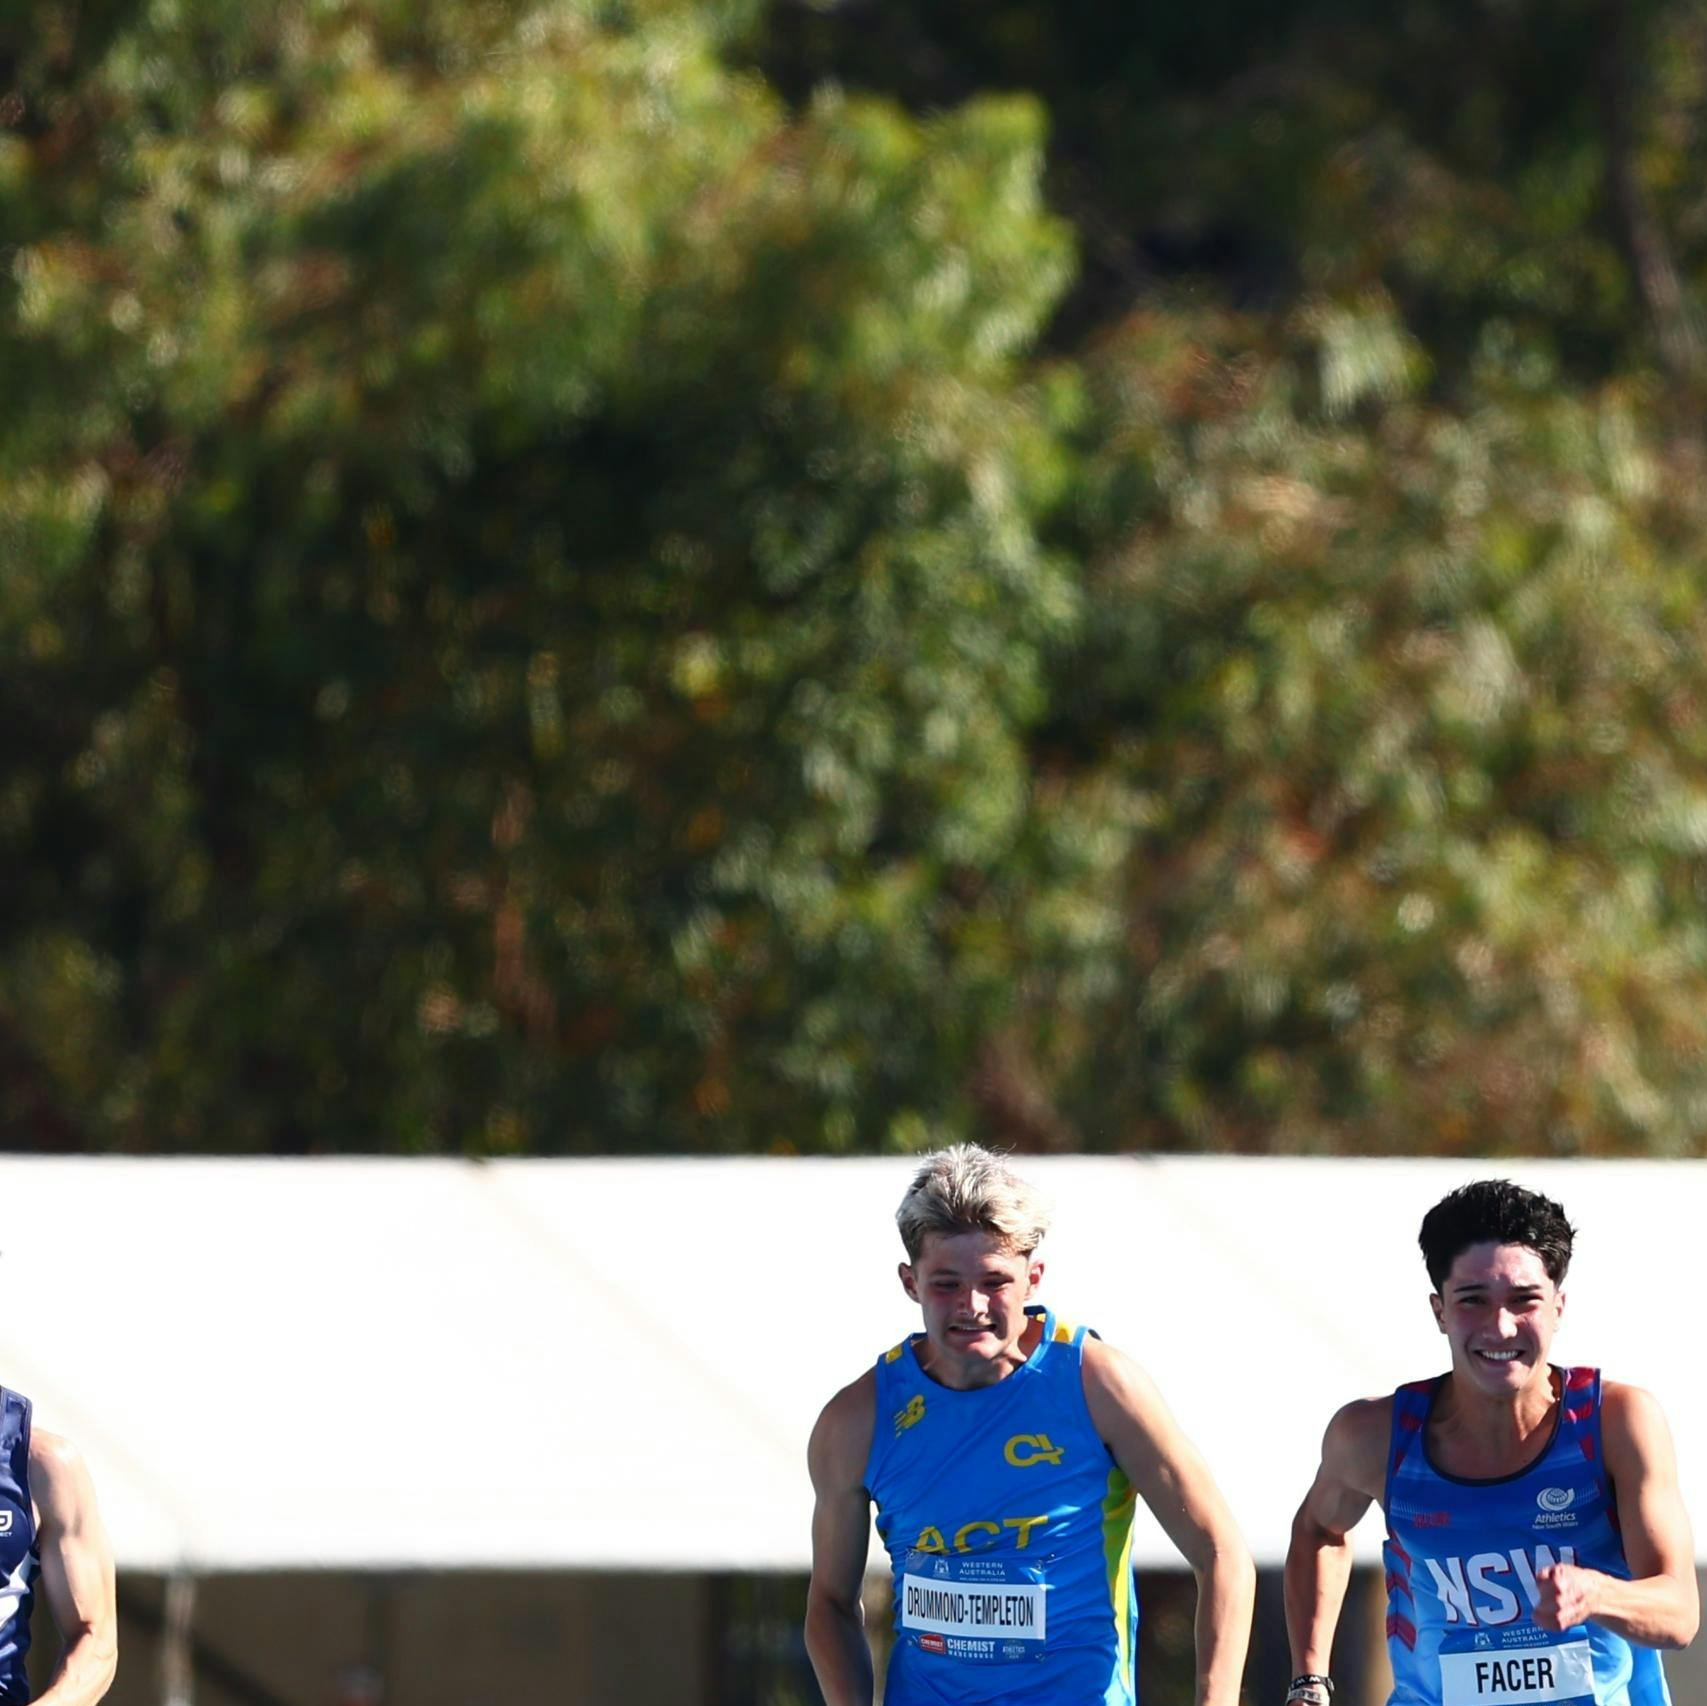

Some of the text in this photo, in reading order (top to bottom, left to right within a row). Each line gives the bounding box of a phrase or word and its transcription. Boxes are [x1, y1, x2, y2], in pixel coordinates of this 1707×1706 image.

[916, 1515, 1050, 1555] ACT
[959, 1568, 1006, 1576] AUSTRALIA
[961, 1561, 1004, 1569] WESTERN
[1424, 1544, 1578, 1627] NSW
[907, 1586, 1034, 1627] DRUMMOND-TEMPLETON
[947, 1638, 996, 1653] CHEMIST
[1501, 1633, 1548, 1644] AUSTRALIA
[1475, 1657, 1555, 1694] FACER
